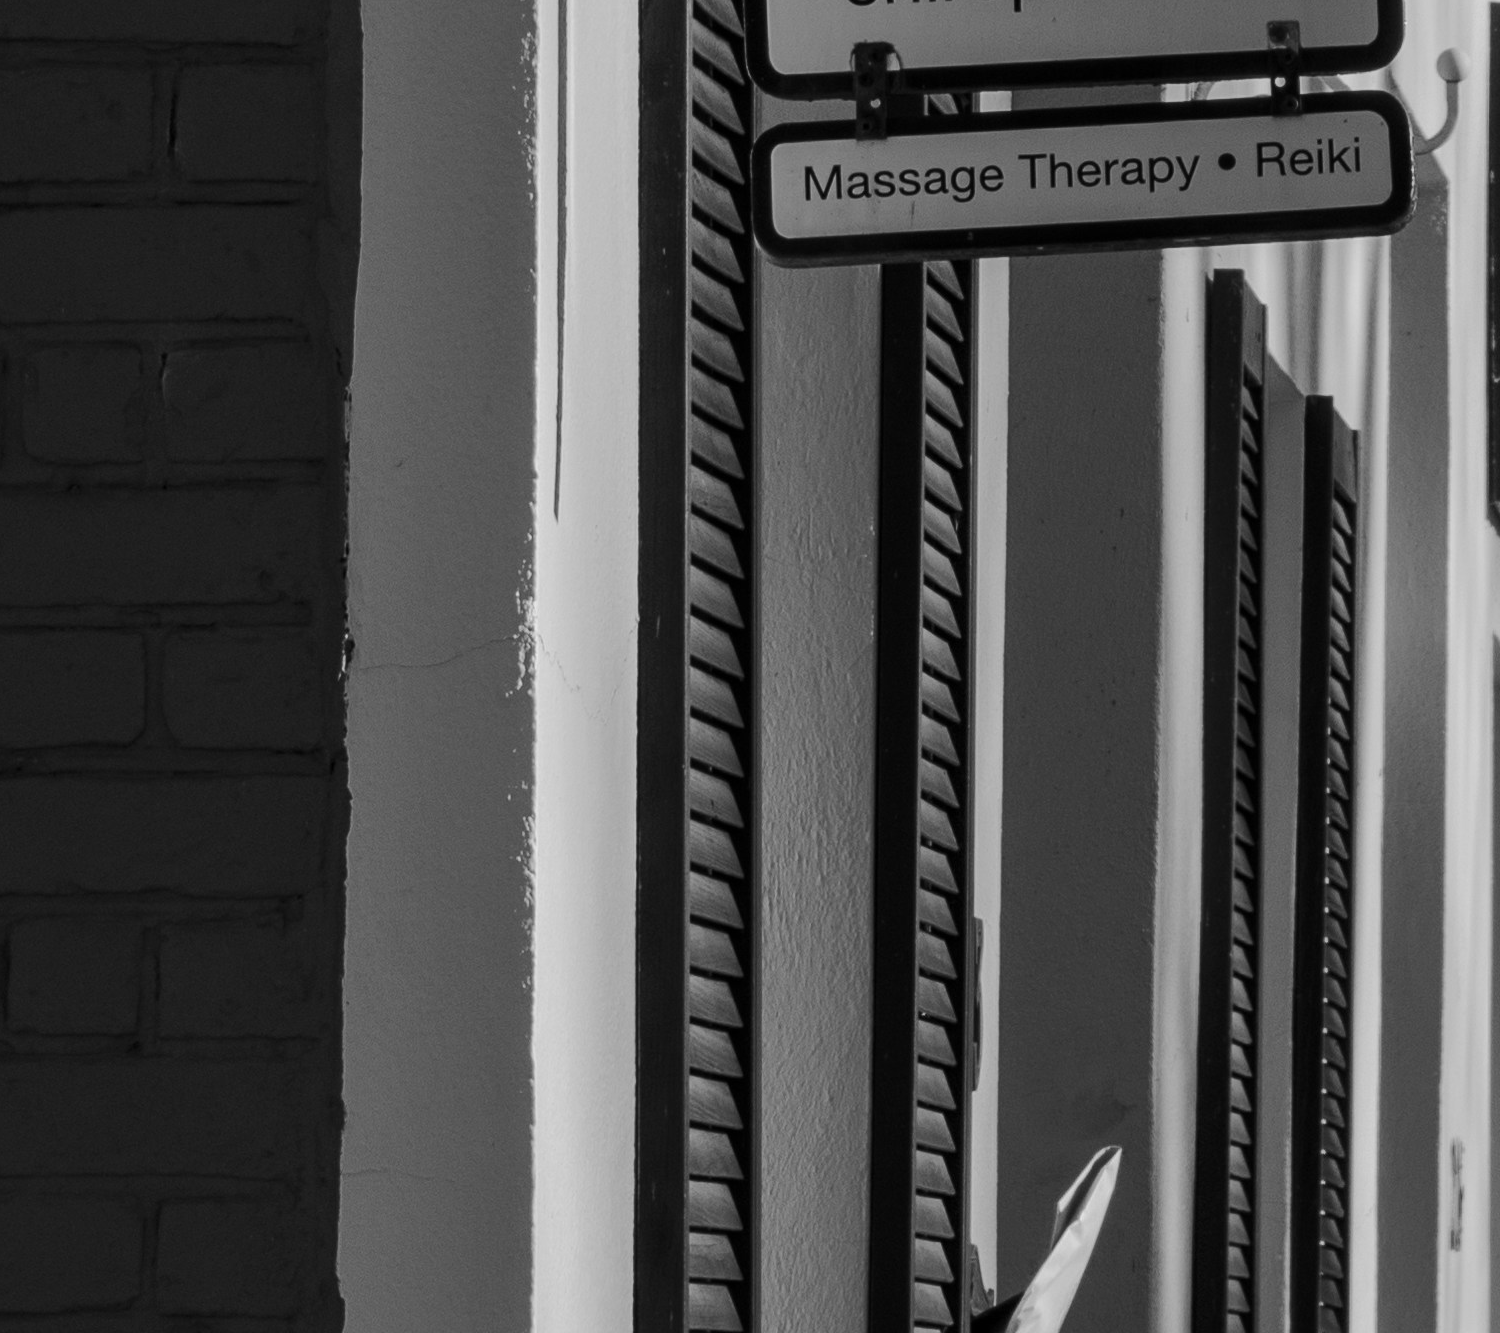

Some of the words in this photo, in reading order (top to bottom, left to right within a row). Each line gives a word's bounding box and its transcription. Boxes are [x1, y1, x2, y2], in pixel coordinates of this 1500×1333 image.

[803, 163, 1004, 203] Massage
[1017, 152, 1201, 193] Therapy
[1255, 136, 1362, 179] Reiki
